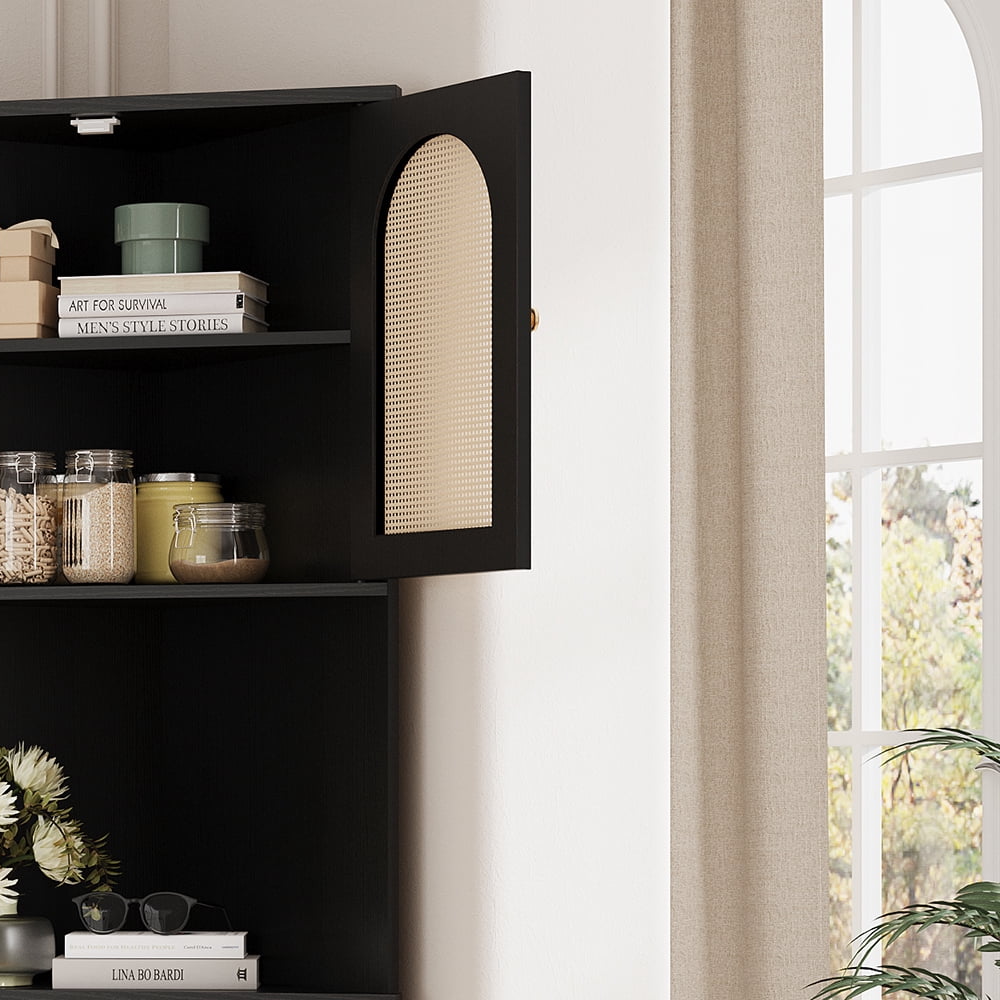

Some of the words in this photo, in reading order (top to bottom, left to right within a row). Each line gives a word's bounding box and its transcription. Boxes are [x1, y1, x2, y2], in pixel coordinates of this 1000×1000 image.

[69, 299, 89, 312] ART
[93, 299, 115, 311] FOR
[118, 298, 167, 310] SURVIVAL
[77, 321, 119, 335] MEN'S
[122, 320, 166, 333] STYLE
[169, 318, 229, 332] STORIES
[112, 968, 136, 981] LINA
[137, 968, 151, 981] BO
[153, 968, 184, 981] BARDI
